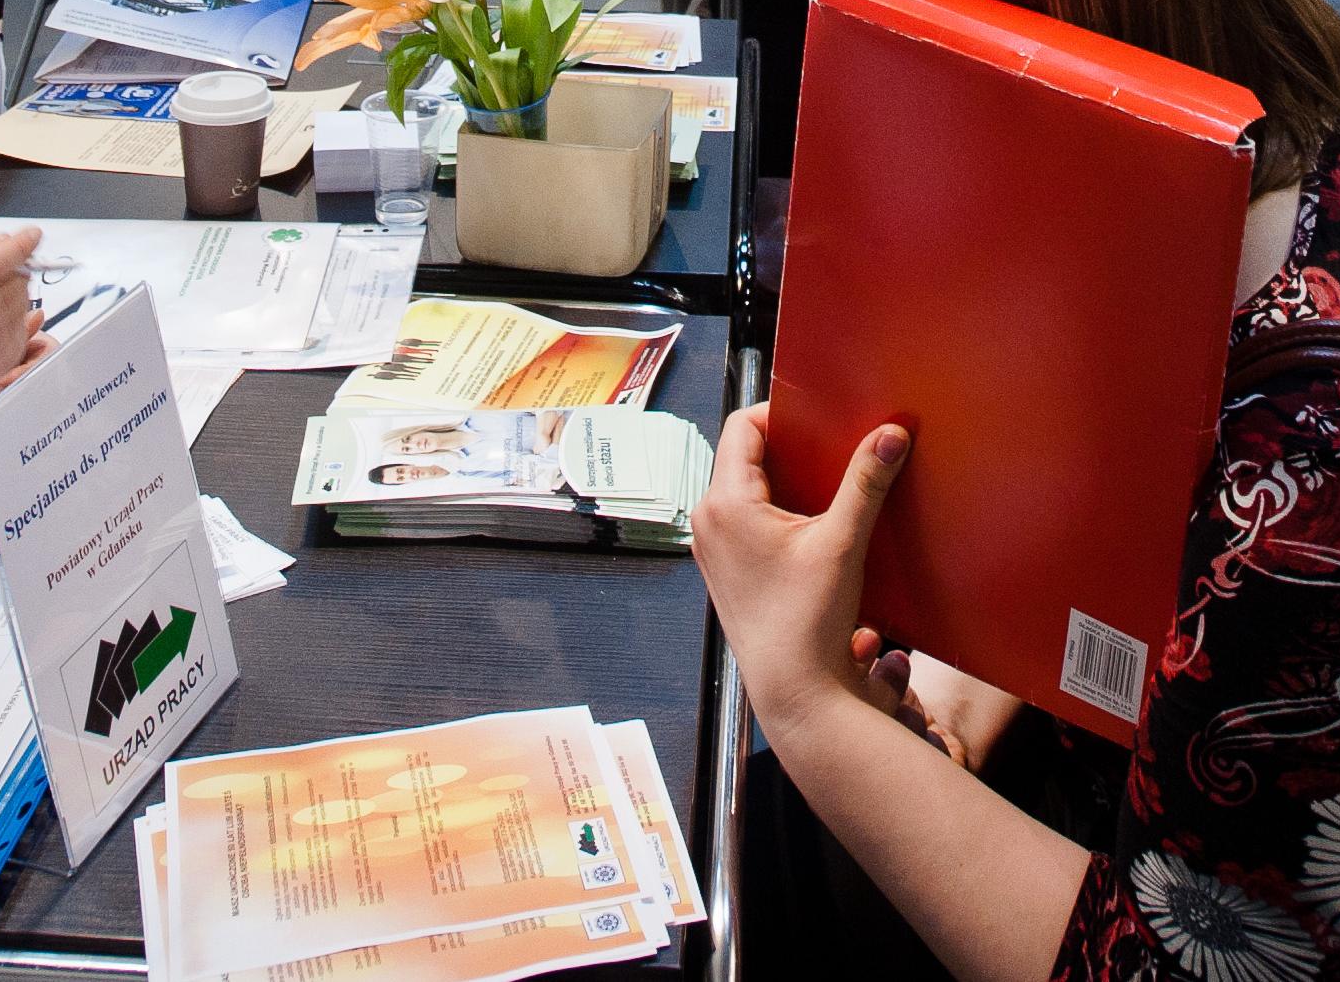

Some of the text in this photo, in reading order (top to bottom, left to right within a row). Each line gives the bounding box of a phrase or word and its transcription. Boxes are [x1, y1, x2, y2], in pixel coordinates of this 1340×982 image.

[3, 386, 169, 542] Specjalista ds. programów
[19, 361, 137, 467] Katarzyna Mielewczyk
[598, 442, 612, 465] stażu
[46, 471, 166, 591] Powiatowy Urząd Pracy
[86, 520, 144, 580] w Gdańsku
[102, 654, 207, 786] URZĄD PRACY
